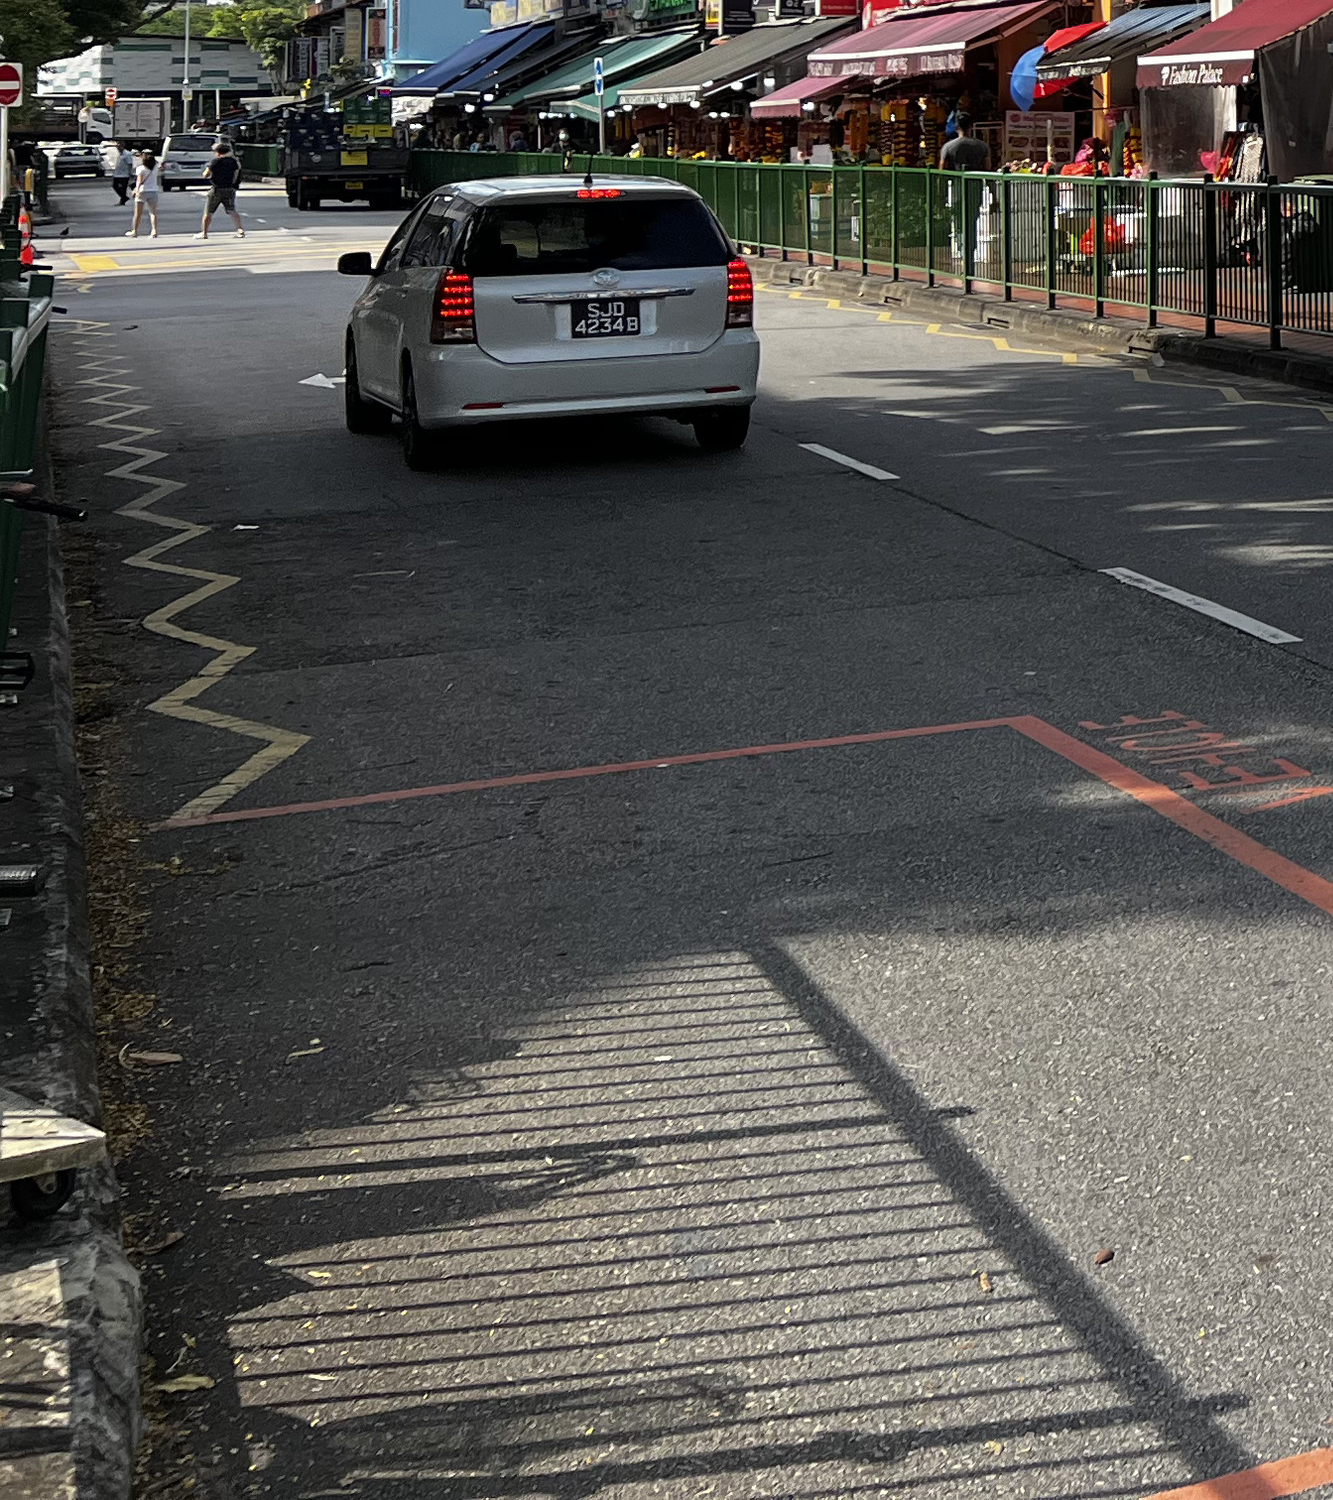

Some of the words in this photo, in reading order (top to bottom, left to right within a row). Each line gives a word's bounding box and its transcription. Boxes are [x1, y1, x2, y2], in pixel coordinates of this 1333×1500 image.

[1169, 65, 1198, 85] Fashion
[1199, 63, 1223, 84] Palace
[587, 302, 624, 318] SJD
[575, 318, 639, 335] 4234B
